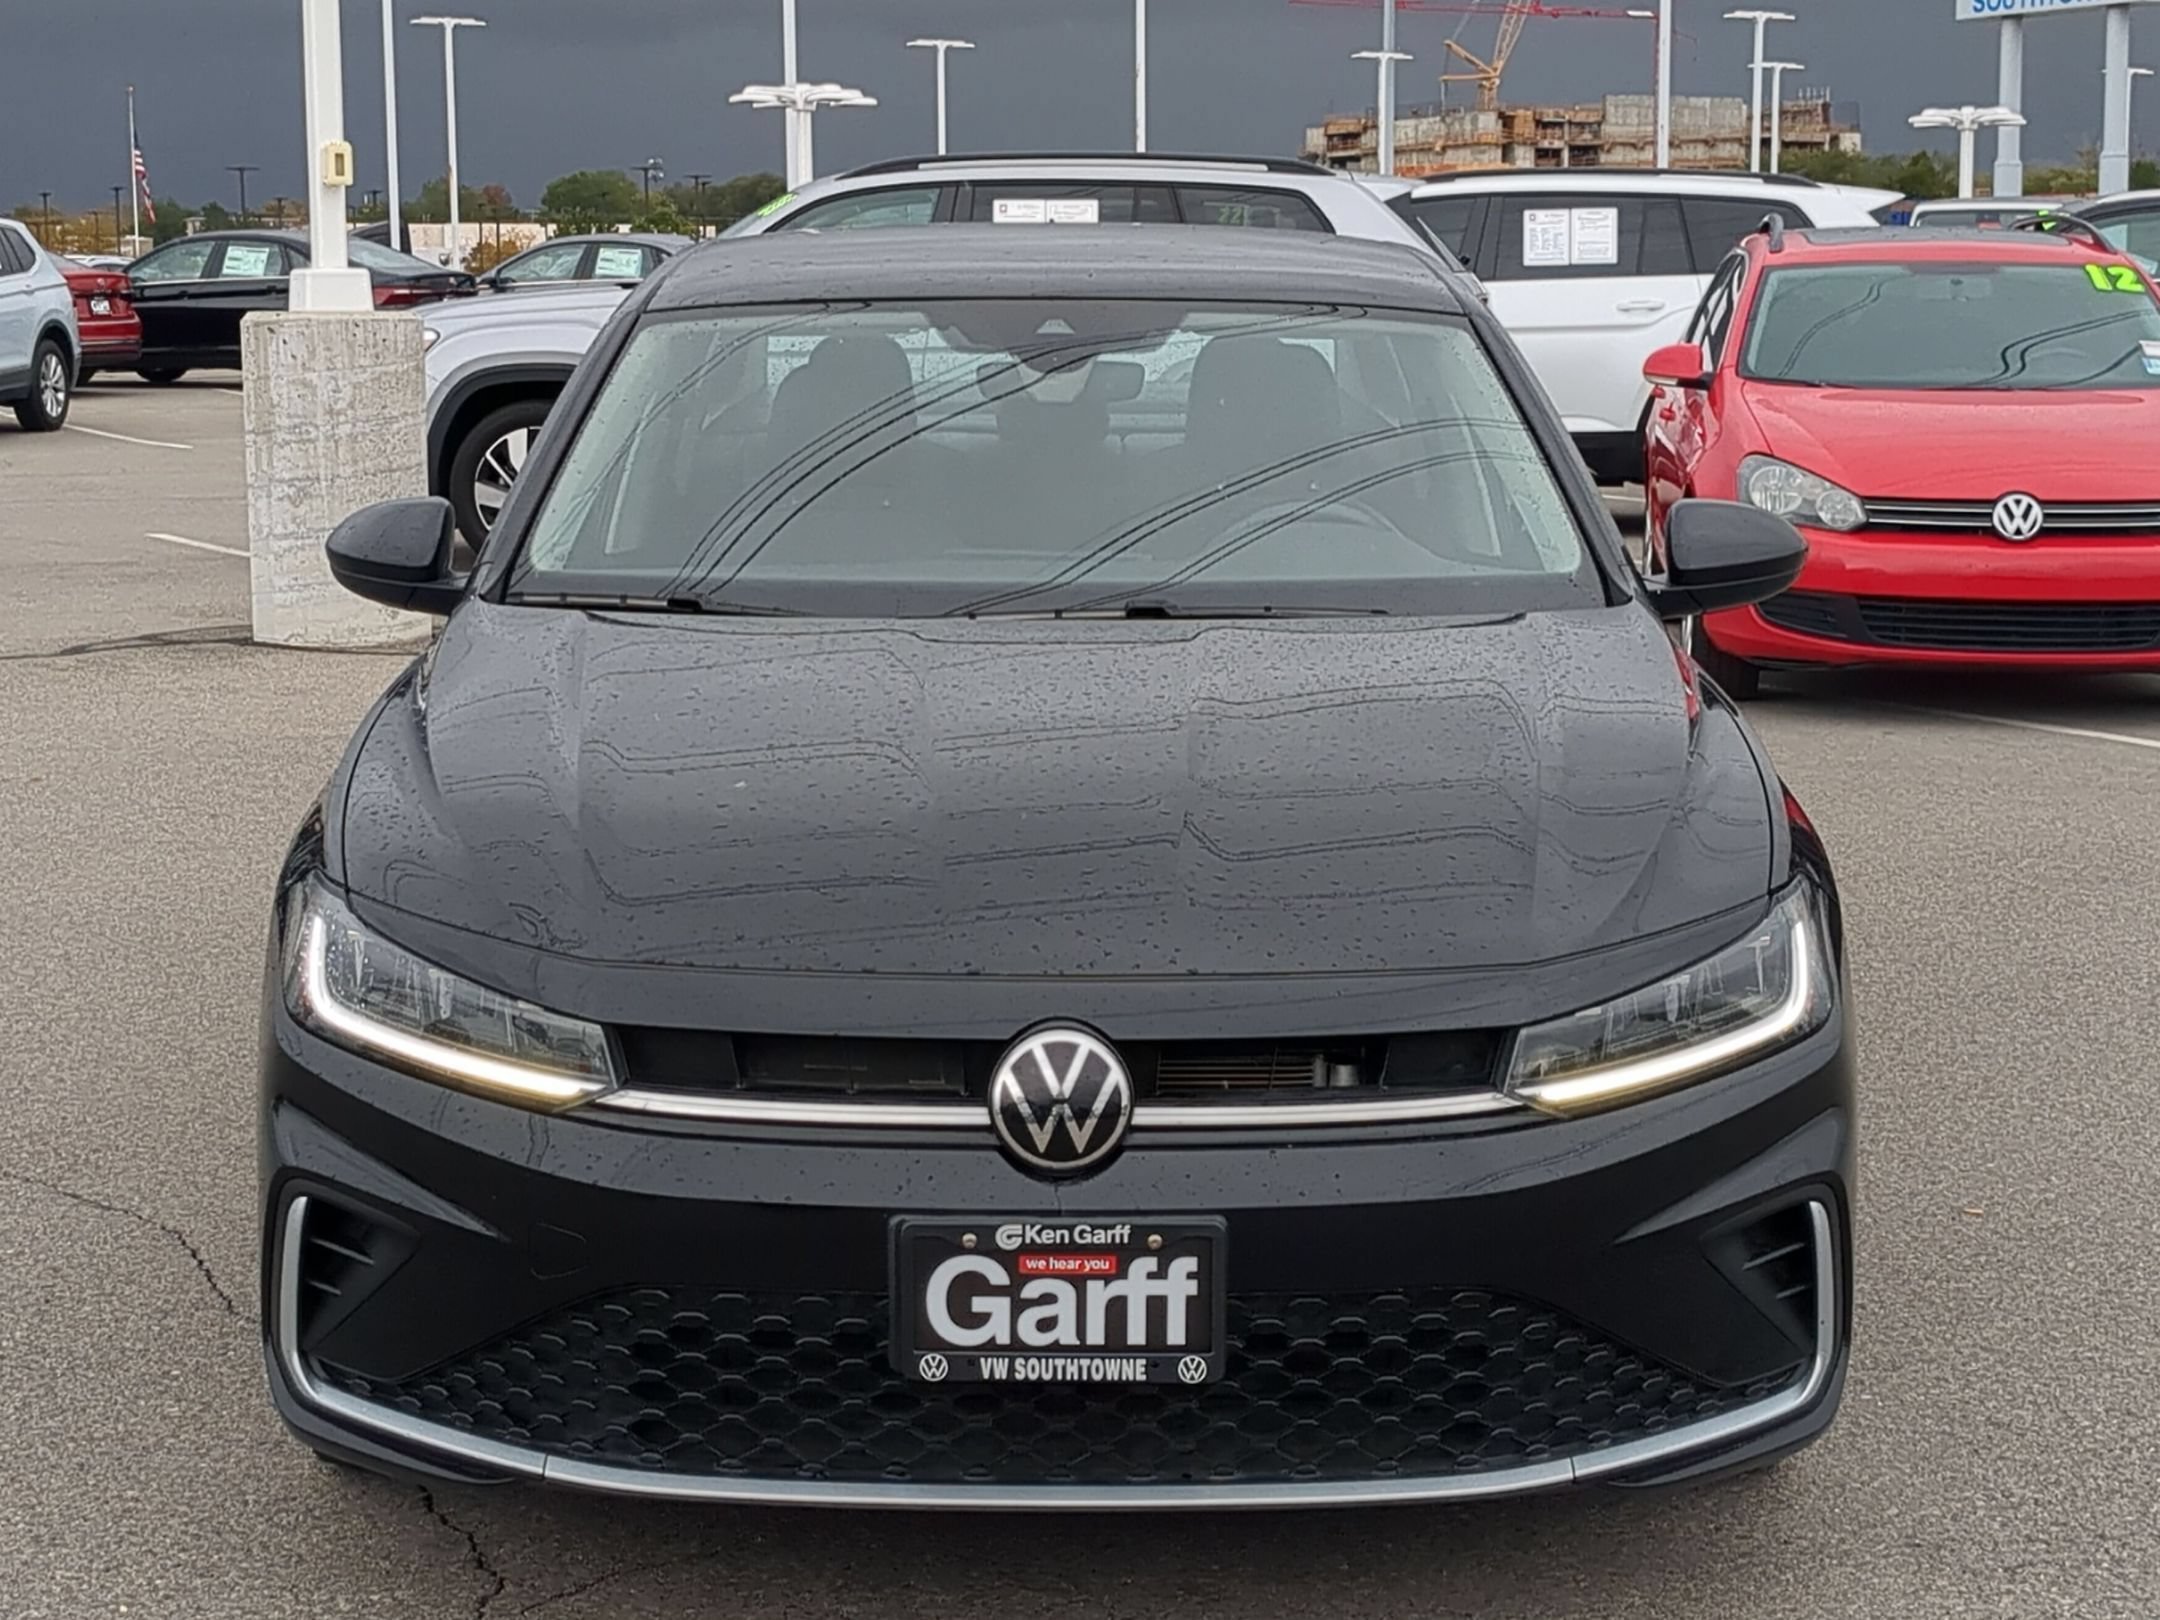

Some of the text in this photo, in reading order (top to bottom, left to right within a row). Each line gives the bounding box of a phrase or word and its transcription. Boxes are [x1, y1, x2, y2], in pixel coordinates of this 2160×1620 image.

[2084, 264, 2146, 292] 12
[996, 1034, 1126, 1160] VW
[1024, 1224, 1069, 1244] Ken
[1073, 1224, 1131, 1244] Garff
[1026, 1257, 1109, 1272] we hear you
[926, 1254, 1198, 1346] Garff
[980, 1357, 1147, 1381] VW SOUTHTOWNE
